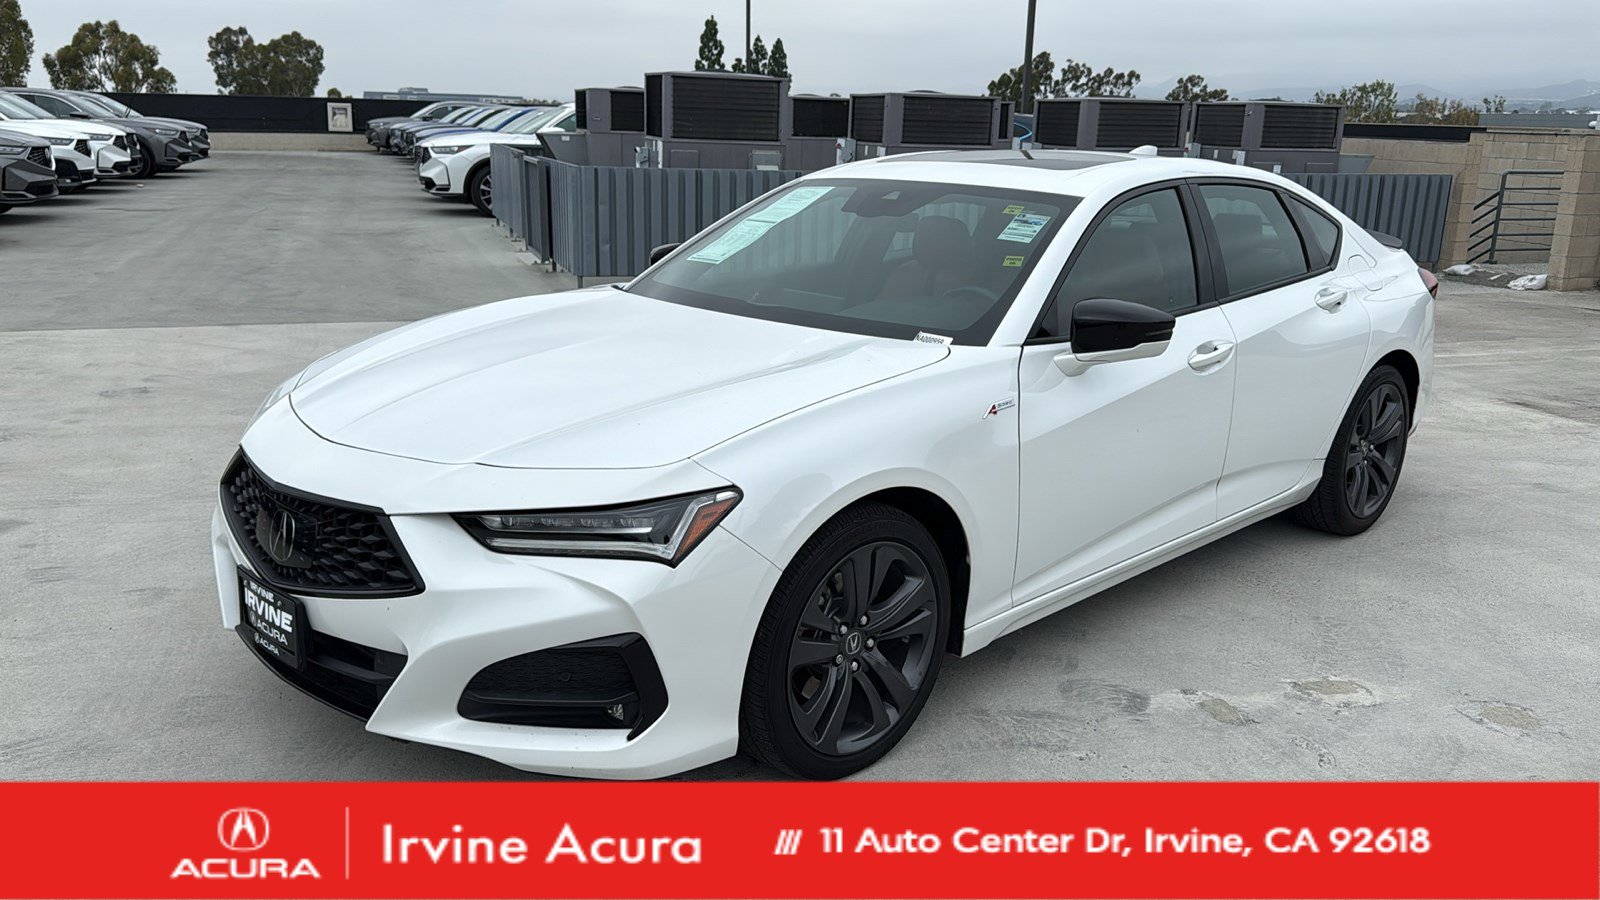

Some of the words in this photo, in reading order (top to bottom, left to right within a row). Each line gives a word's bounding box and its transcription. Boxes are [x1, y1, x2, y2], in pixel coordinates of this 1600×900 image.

[250, 580, 274, 602] IRVINE
[244, 587, 293, 633] IRVINE
[256, 619, 288, 646] ACURA
[259, 638, 280, 656] ACURA
